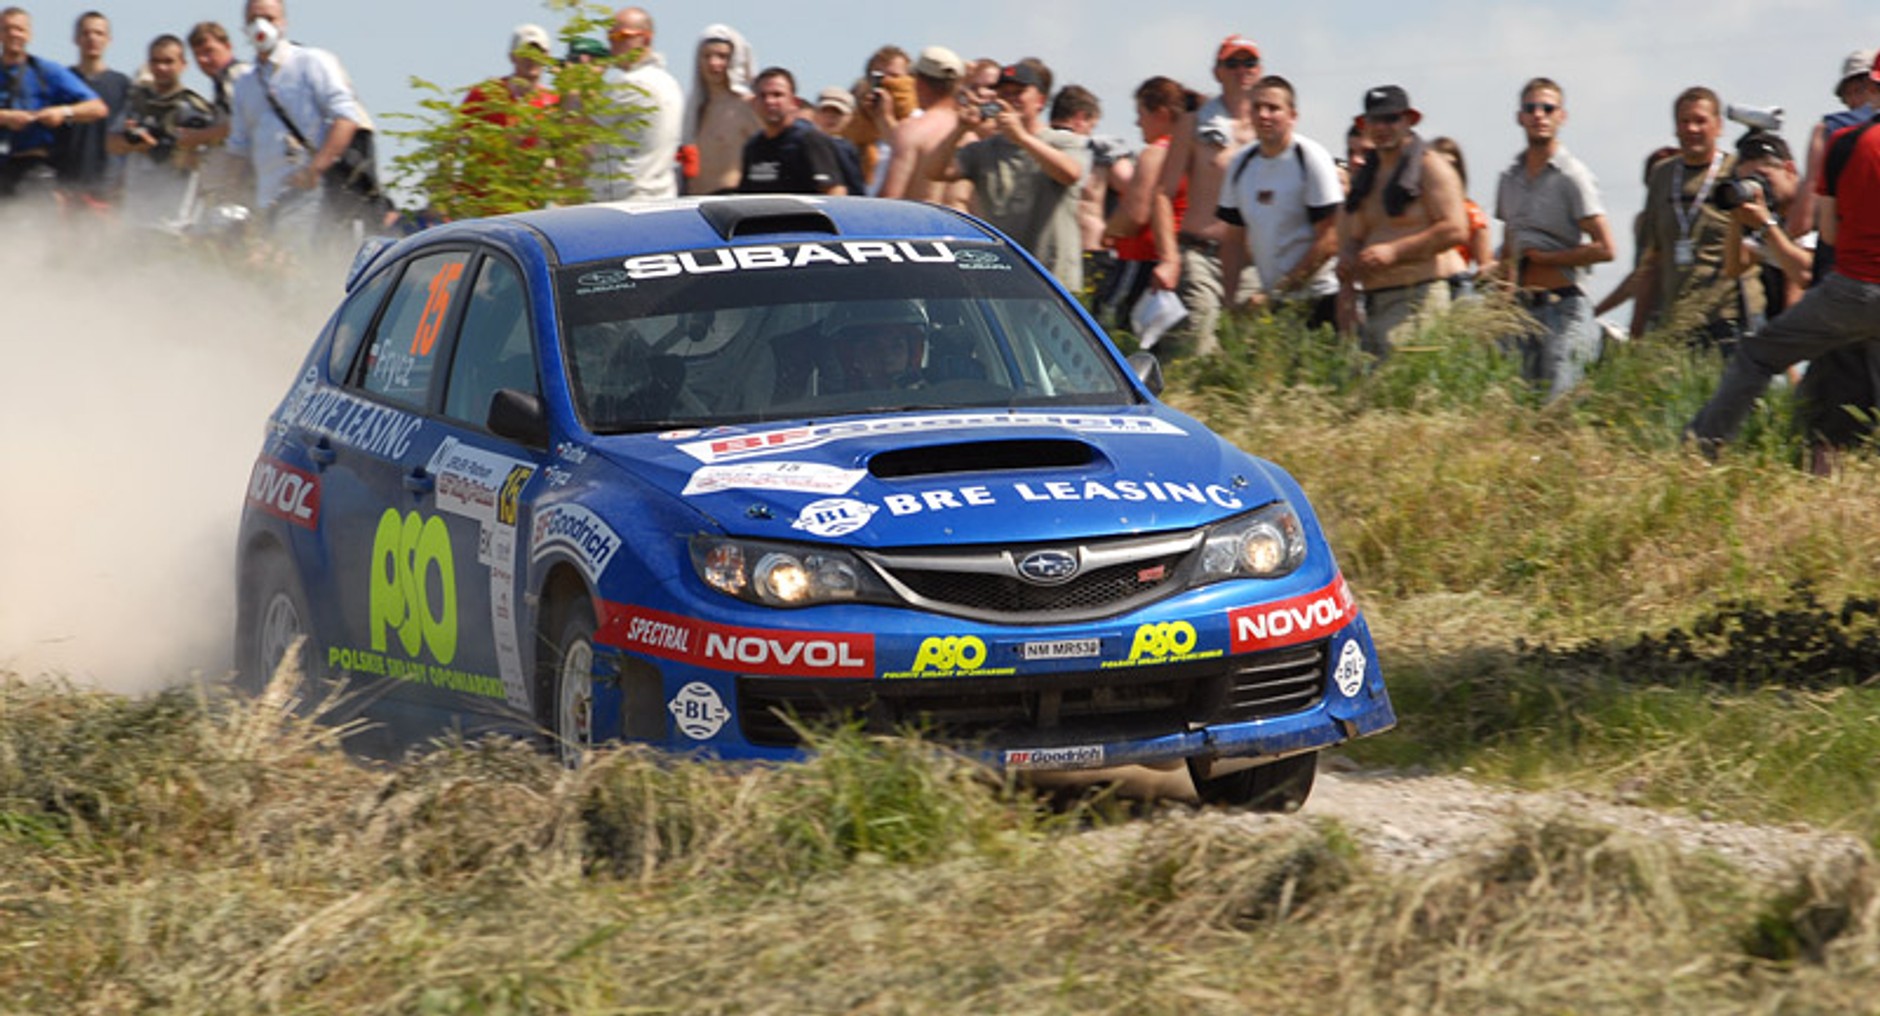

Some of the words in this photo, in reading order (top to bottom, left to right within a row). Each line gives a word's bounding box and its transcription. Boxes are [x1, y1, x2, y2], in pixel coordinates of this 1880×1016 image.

[624, 241, 956, 280] SUBARU
[410, 263, 464, 357] 15
[817, 505, 857, 525] BL
[883, 484, 996, 518] BRE
[1014, 479, 1243, 510] LEASING
[534, 507, 612, 564] BFGoodrich
[369, 507, 458, 666] PSO
[1237, 596, 1344, 642] NOVOL
[626, 615, 691, 652] SPECTRAL
[705, 632, 866, 668] NOVOL
[911, 634, 988, 673] PSO
[1027, 644, 1049, 657] NM
[1128, 620, 1198, 661] PSO
[328, 646, 386, 676] POLSKIE
[685, 700, 713, 722] BL
